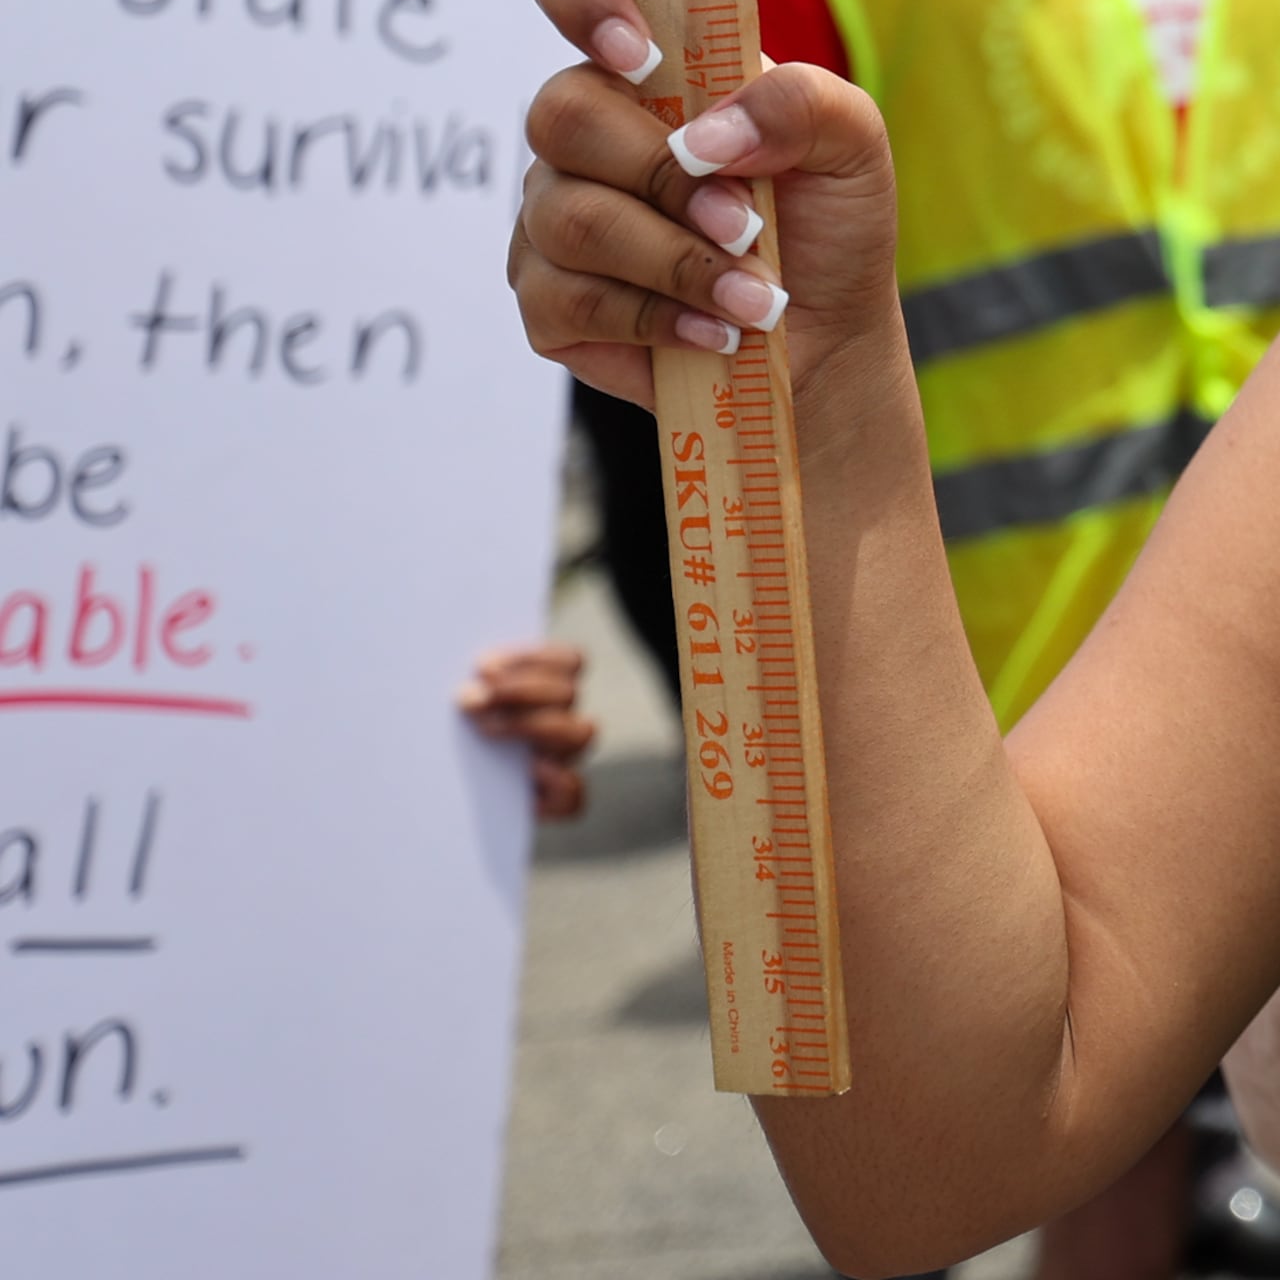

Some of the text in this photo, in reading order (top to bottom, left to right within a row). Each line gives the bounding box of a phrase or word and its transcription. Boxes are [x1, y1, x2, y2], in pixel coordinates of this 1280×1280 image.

[682, 45, 707, 89] 27
[130, 266, 424, 388] then
[711, 382, 738, 429] 30
[0, 422, 132, 529] be
[722, 495, 747, 539] 31
[0, 560, 258, 676] able.
[671, 431, 734, 801] SKU# 611 269
[732, 608, 757, 656] 32
[741, 721, 767, 770] 33
[751, 835, 775, 883] 34
[761, 949, 786, 995] 35
[769, 1035, 791, 1078] 36
